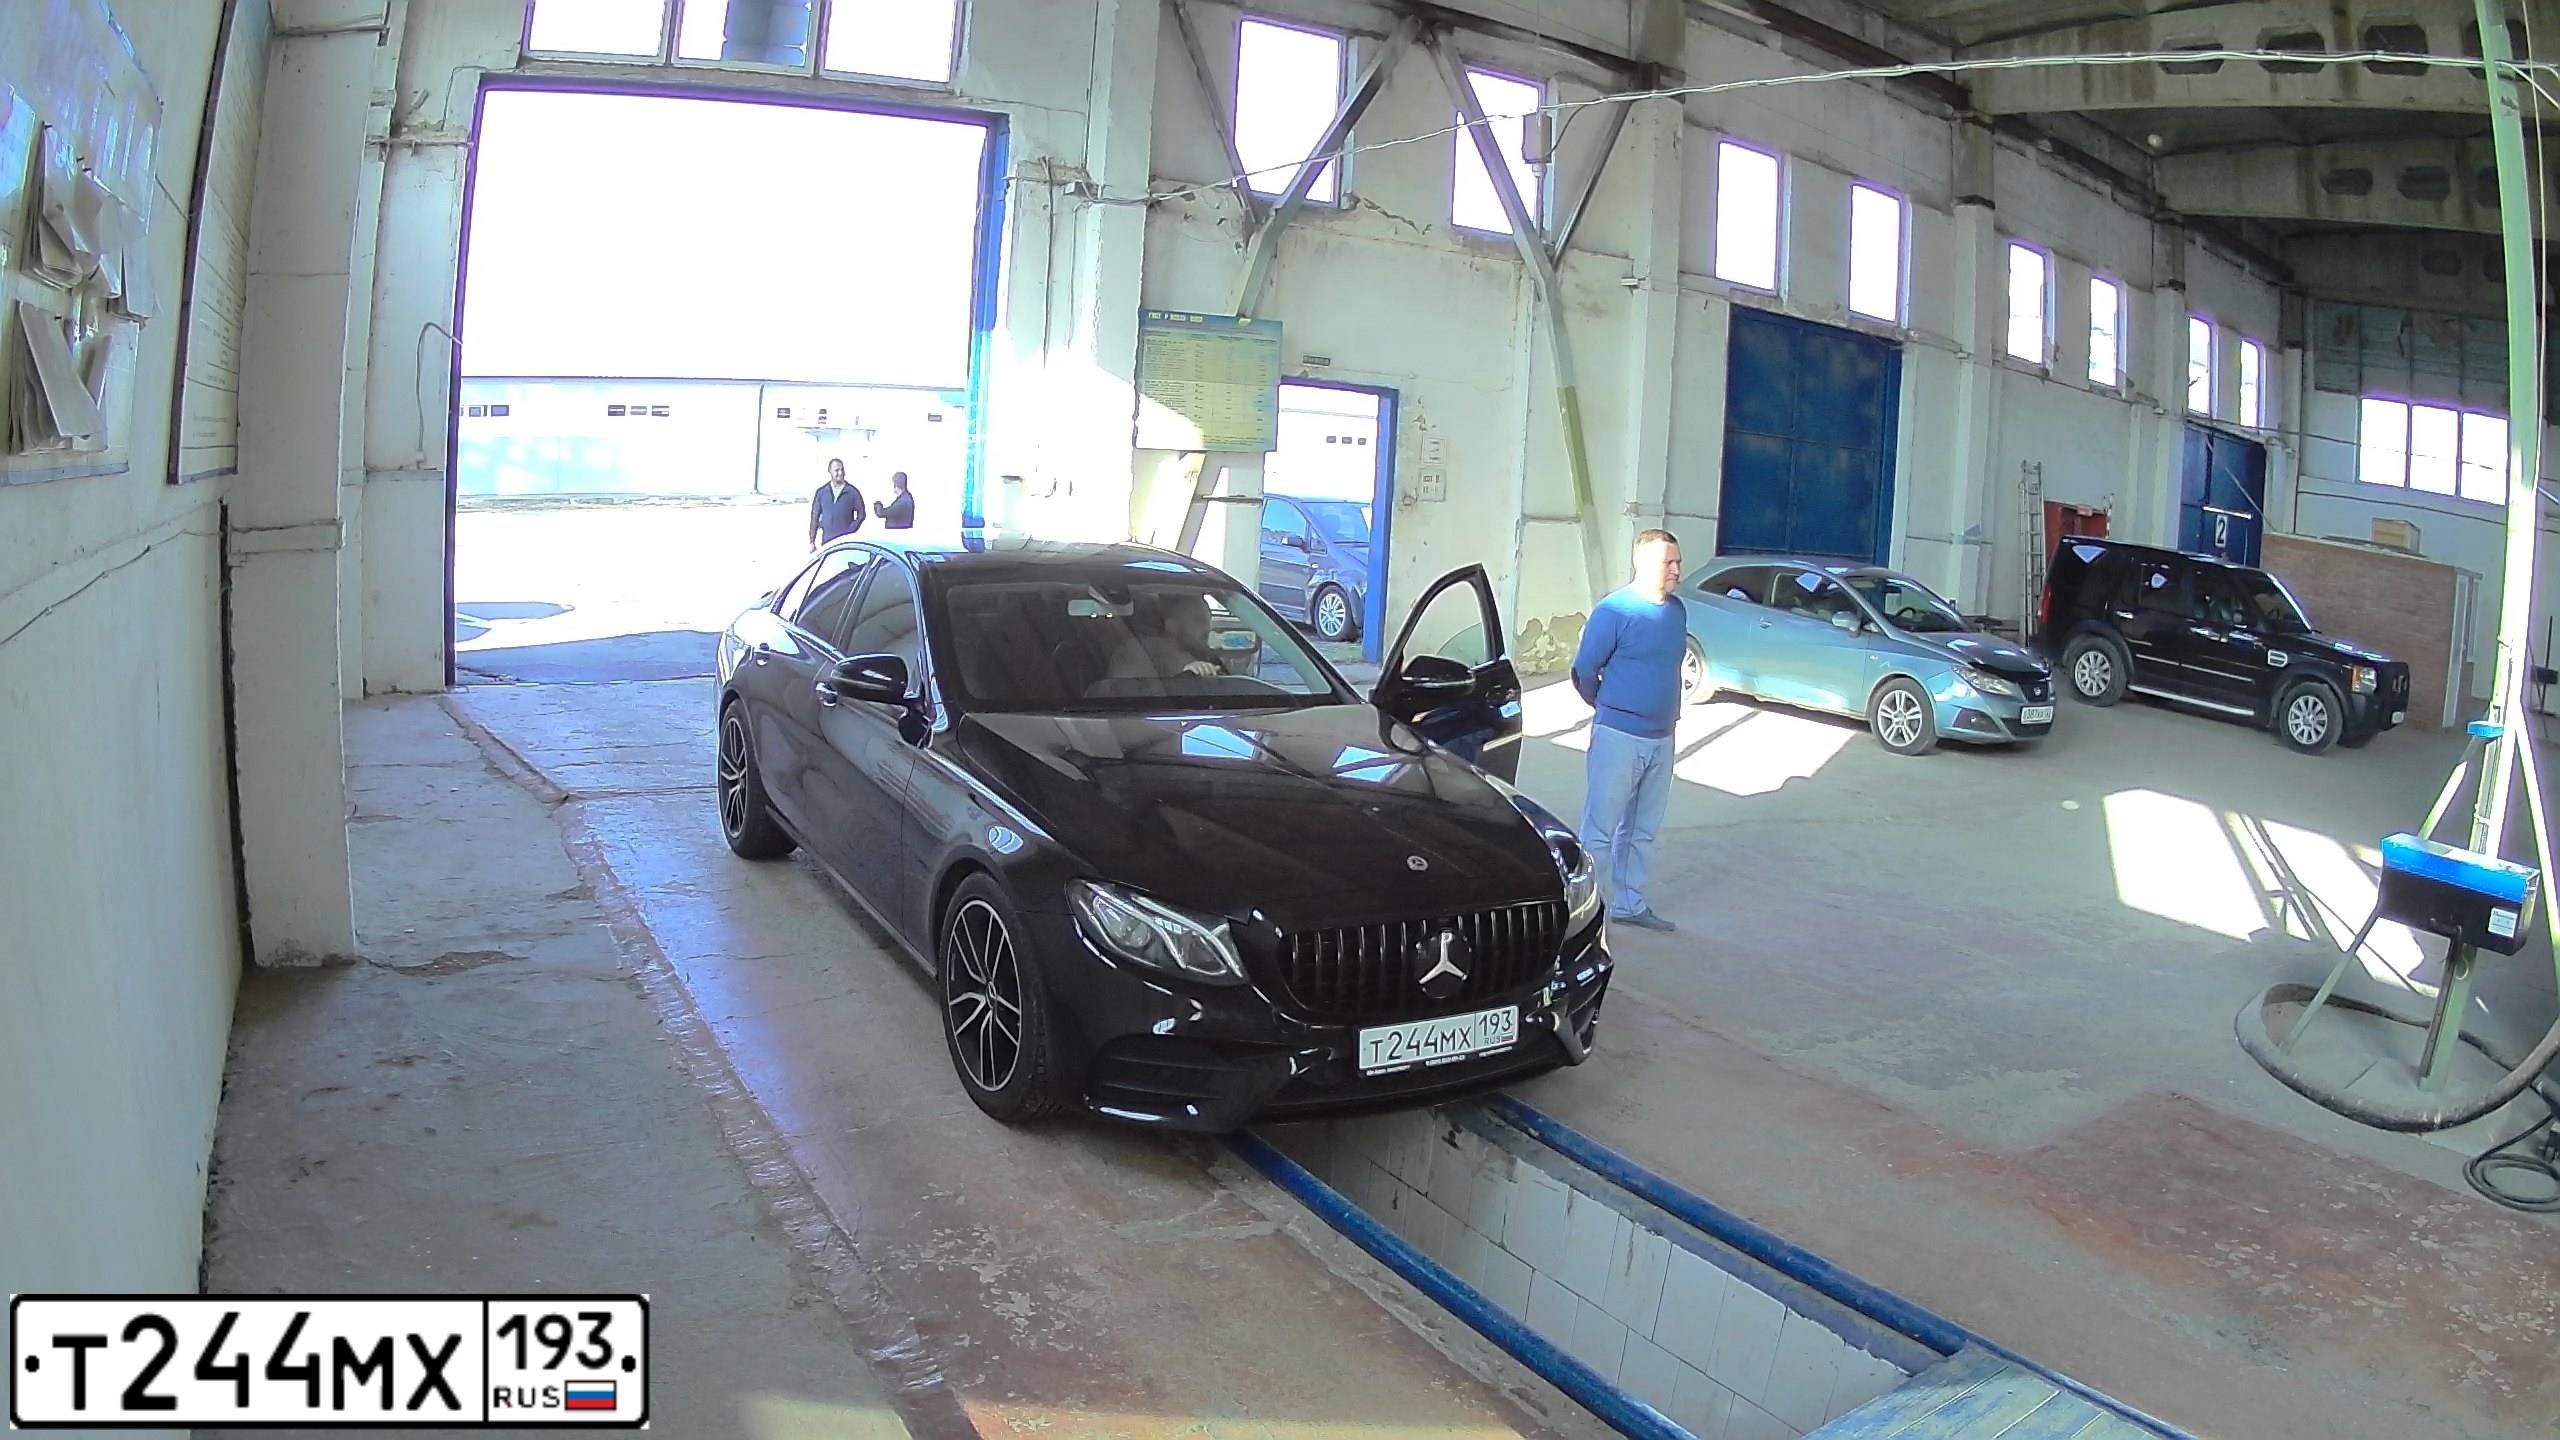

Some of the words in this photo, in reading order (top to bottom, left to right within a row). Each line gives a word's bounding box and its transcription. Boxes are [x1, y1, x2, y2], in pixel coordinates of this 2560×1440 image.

[2216, 519, 2225, 543] 2
[1370, 1025, 1471, 1063] Т244МХ
[1479, 1011, 1512, 1036] 193
[1484, 1036, 1501, 1046] RUS
